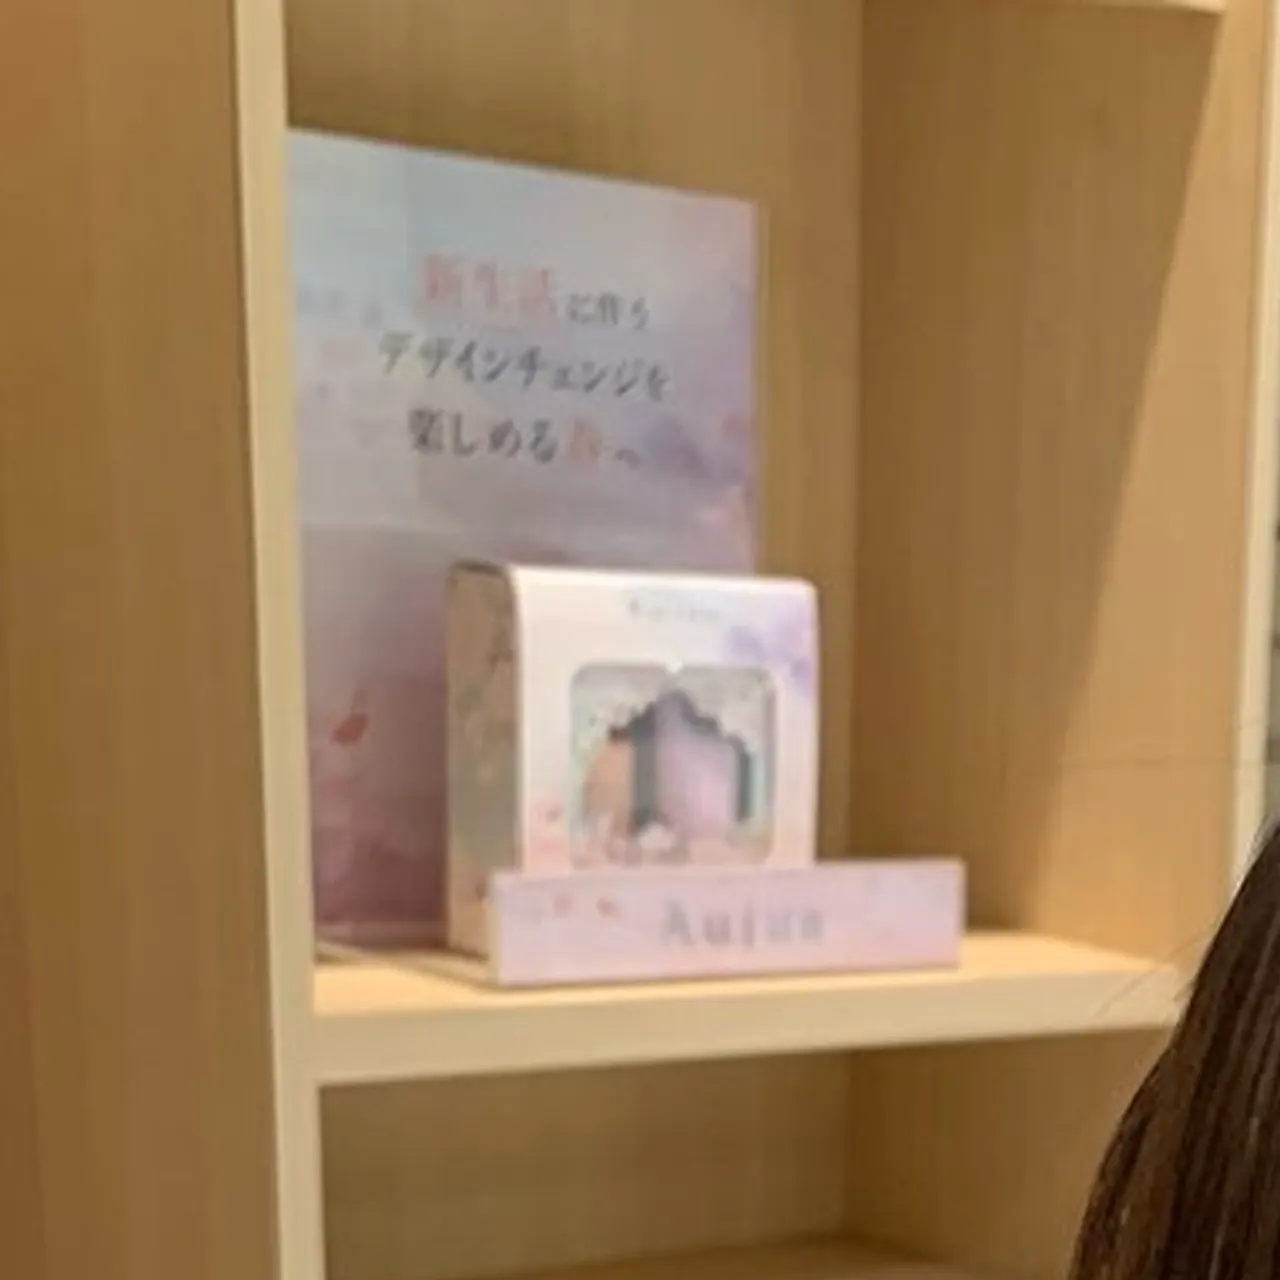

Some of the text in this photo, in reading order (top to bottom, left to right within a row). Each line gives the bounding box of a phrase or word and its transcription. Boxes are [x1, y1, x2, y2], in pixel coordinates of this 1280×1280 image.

[379, 331, 674, 401] デザインチェンジを
